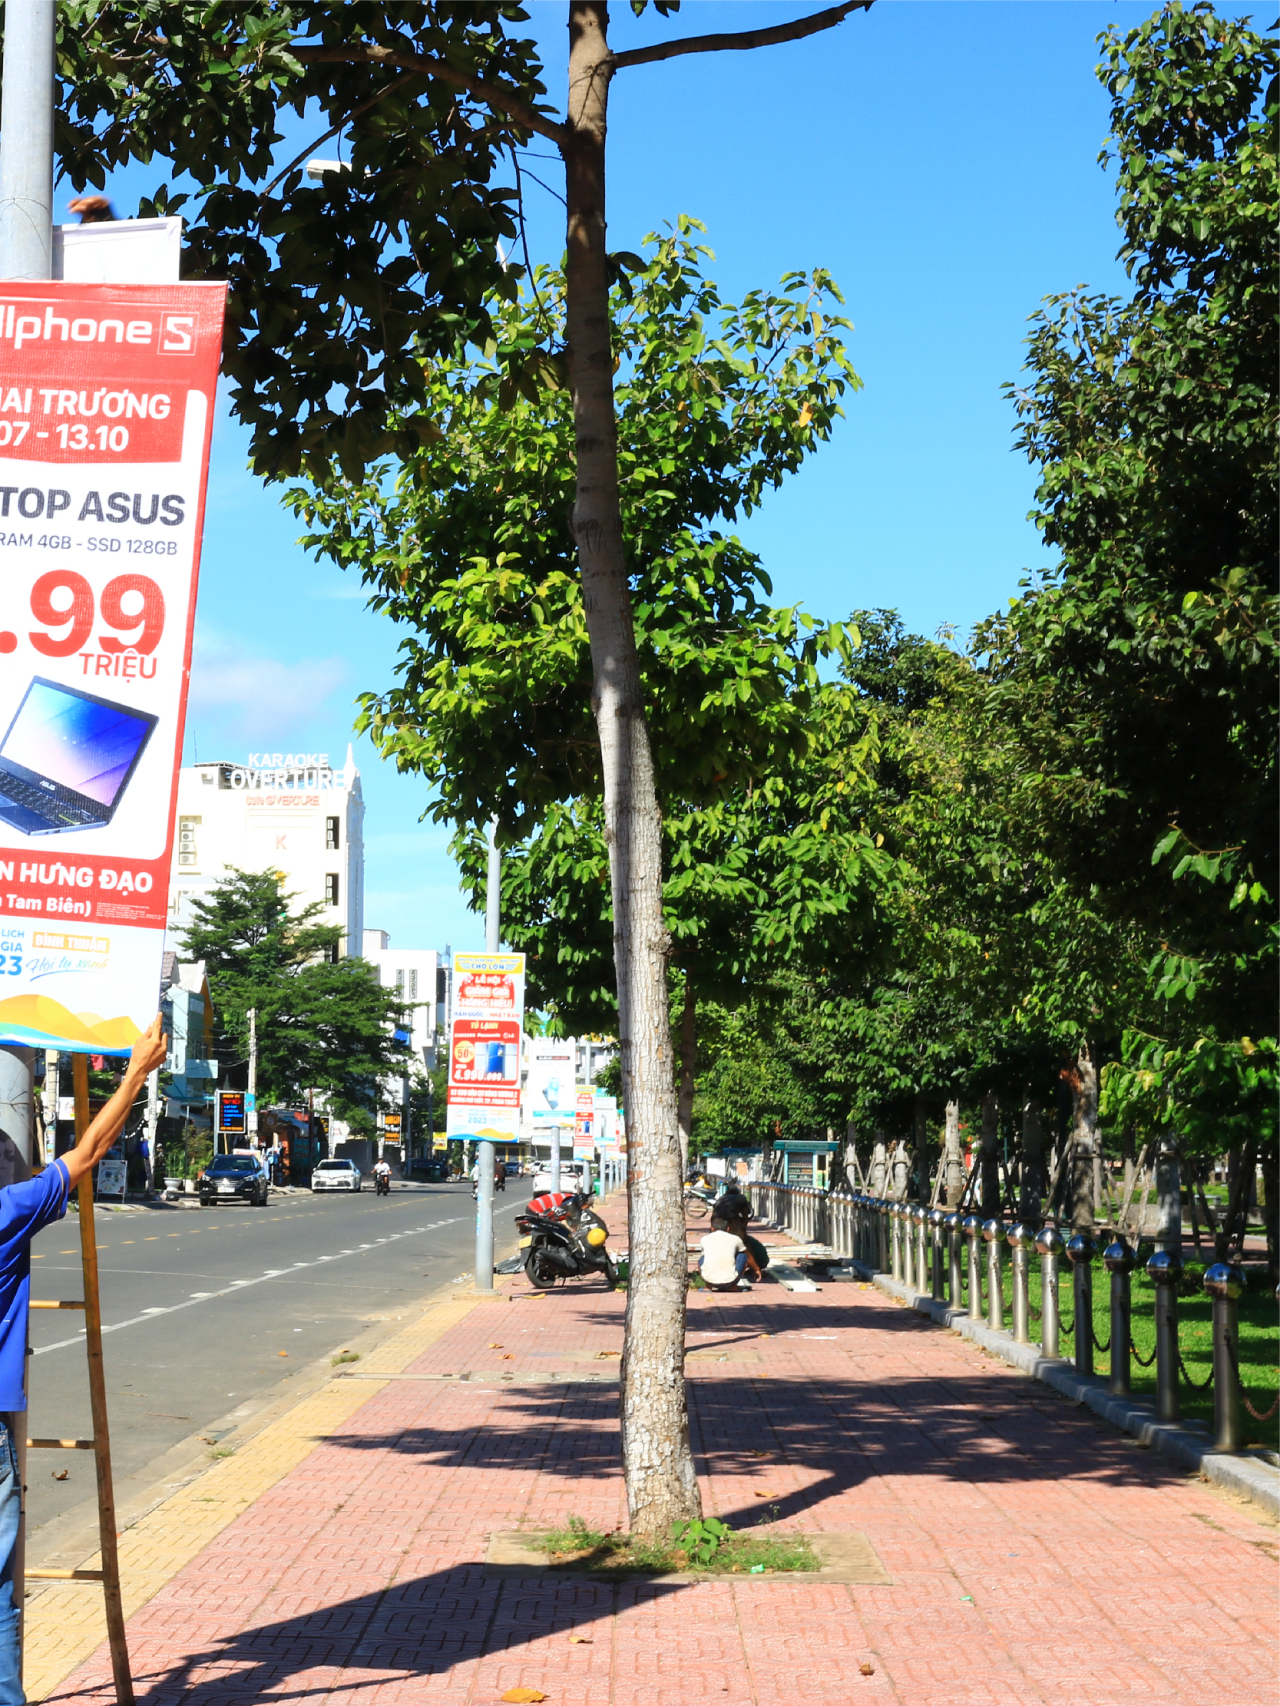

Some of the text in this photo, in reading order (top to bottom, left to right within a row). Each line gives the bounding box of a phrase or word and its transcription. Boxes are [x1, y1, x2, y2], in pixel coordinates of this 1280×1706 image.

[38, 386, 171, 420] TRƯƠNG
[55, 424, 130, 453] 13.10
[77, 490, 187, 527] ASUS
[37, 533, 72, 550] 4GB
[86, 537, 122, 554] SSD
[125, 538, 179, 557] 128GB
[78, 649, 158, 683] TRIỆU
[248, 753, 329, 768] KARAOKE
[230, 769, 345, 790] OVERTURE
[19, 859, 94, 889] HƯNG
[98, 868, 153, 897] ĐẠO
[7, 893, 43, 912] Tam
[45, 896, 92, 917] Biên)
[1, 929, 25, 940] LỊCH
[35, 933, 108, 954] BÌNH THUẬN
[0, 940, 24, 954] GIA
